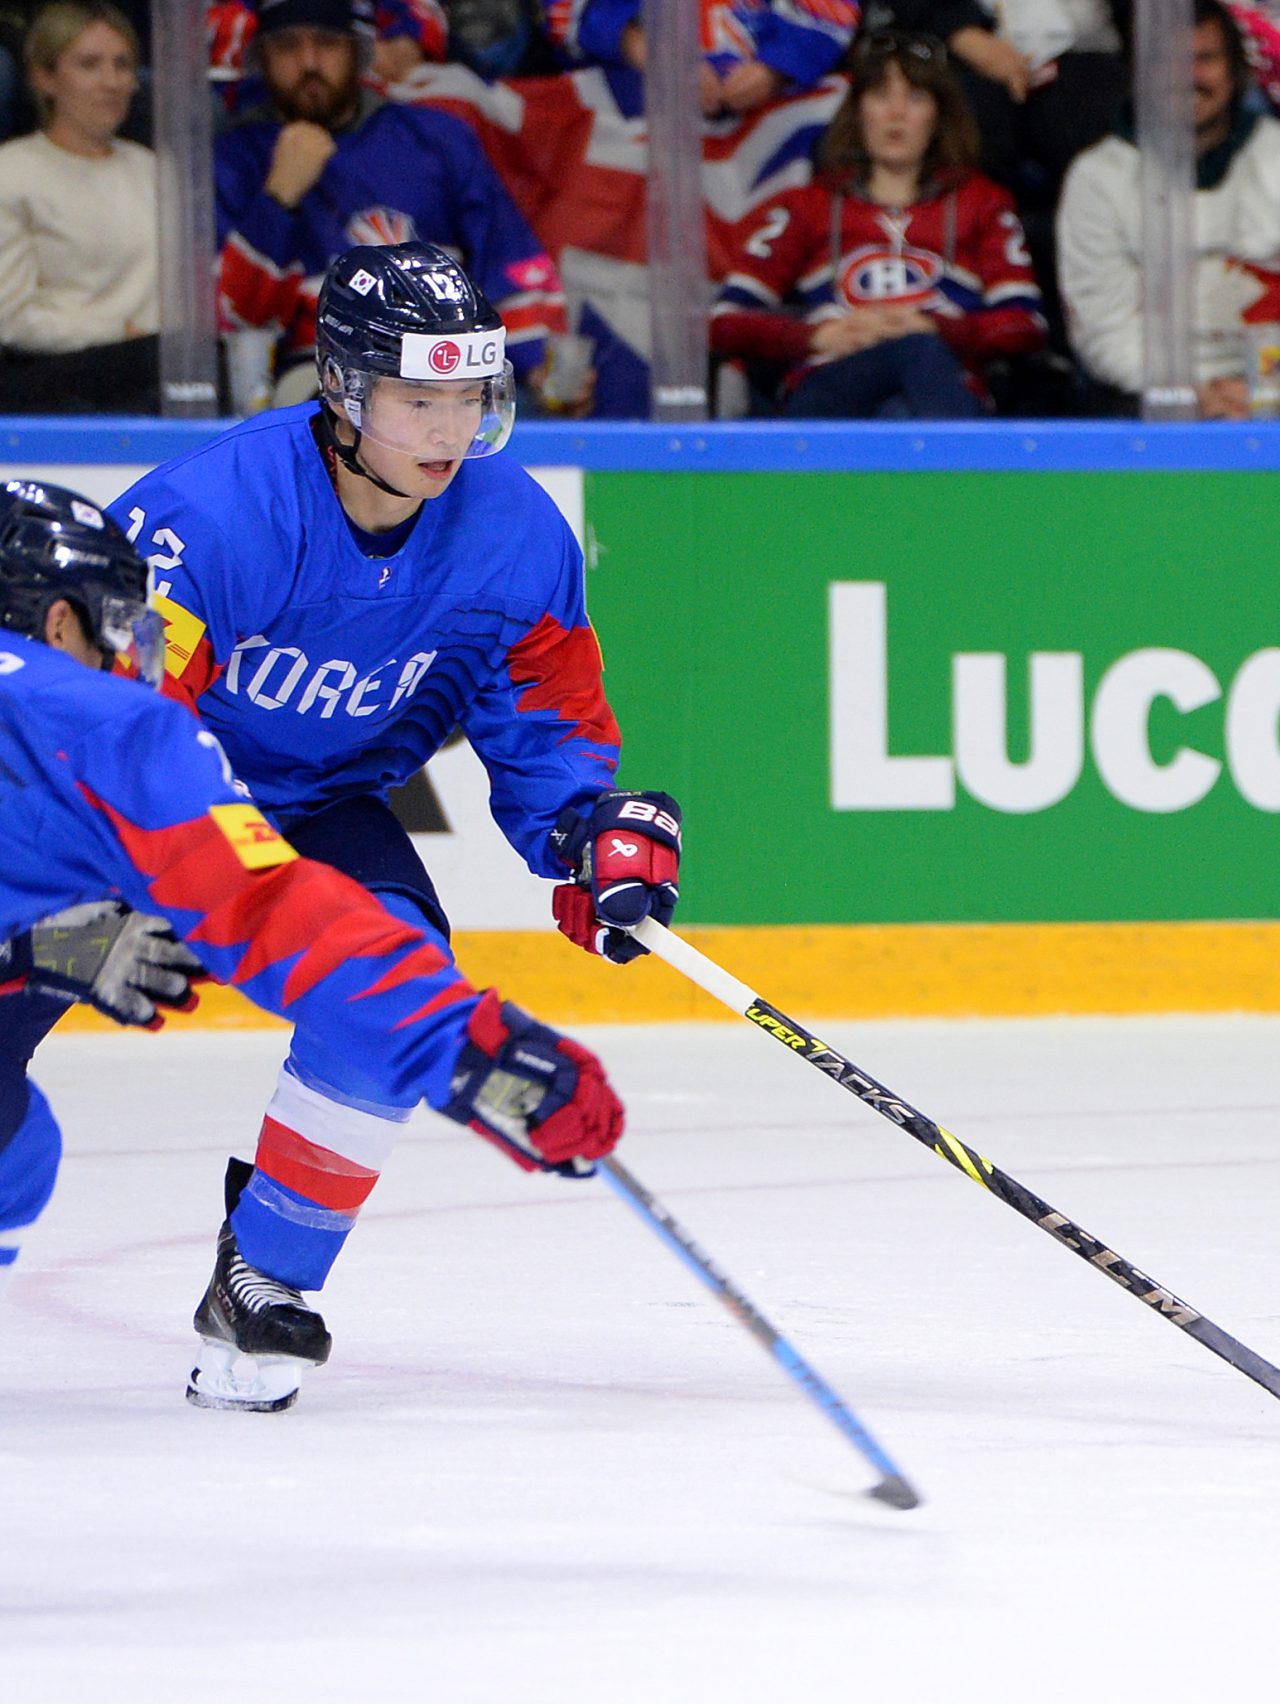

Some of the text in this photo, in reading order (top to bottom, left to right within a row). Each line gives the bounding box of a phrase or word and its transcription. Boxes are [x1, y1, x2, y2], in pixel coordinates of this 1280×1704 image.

[745, 206, 790, 258] 2
[421, 270, 463, 302] 12
[466, 341, 497, 368] LG
[126, 505, 186, 571] 12
[745, 1004, 807, 1050] UPER
[805, 1038, 916, 1126] TACKS
